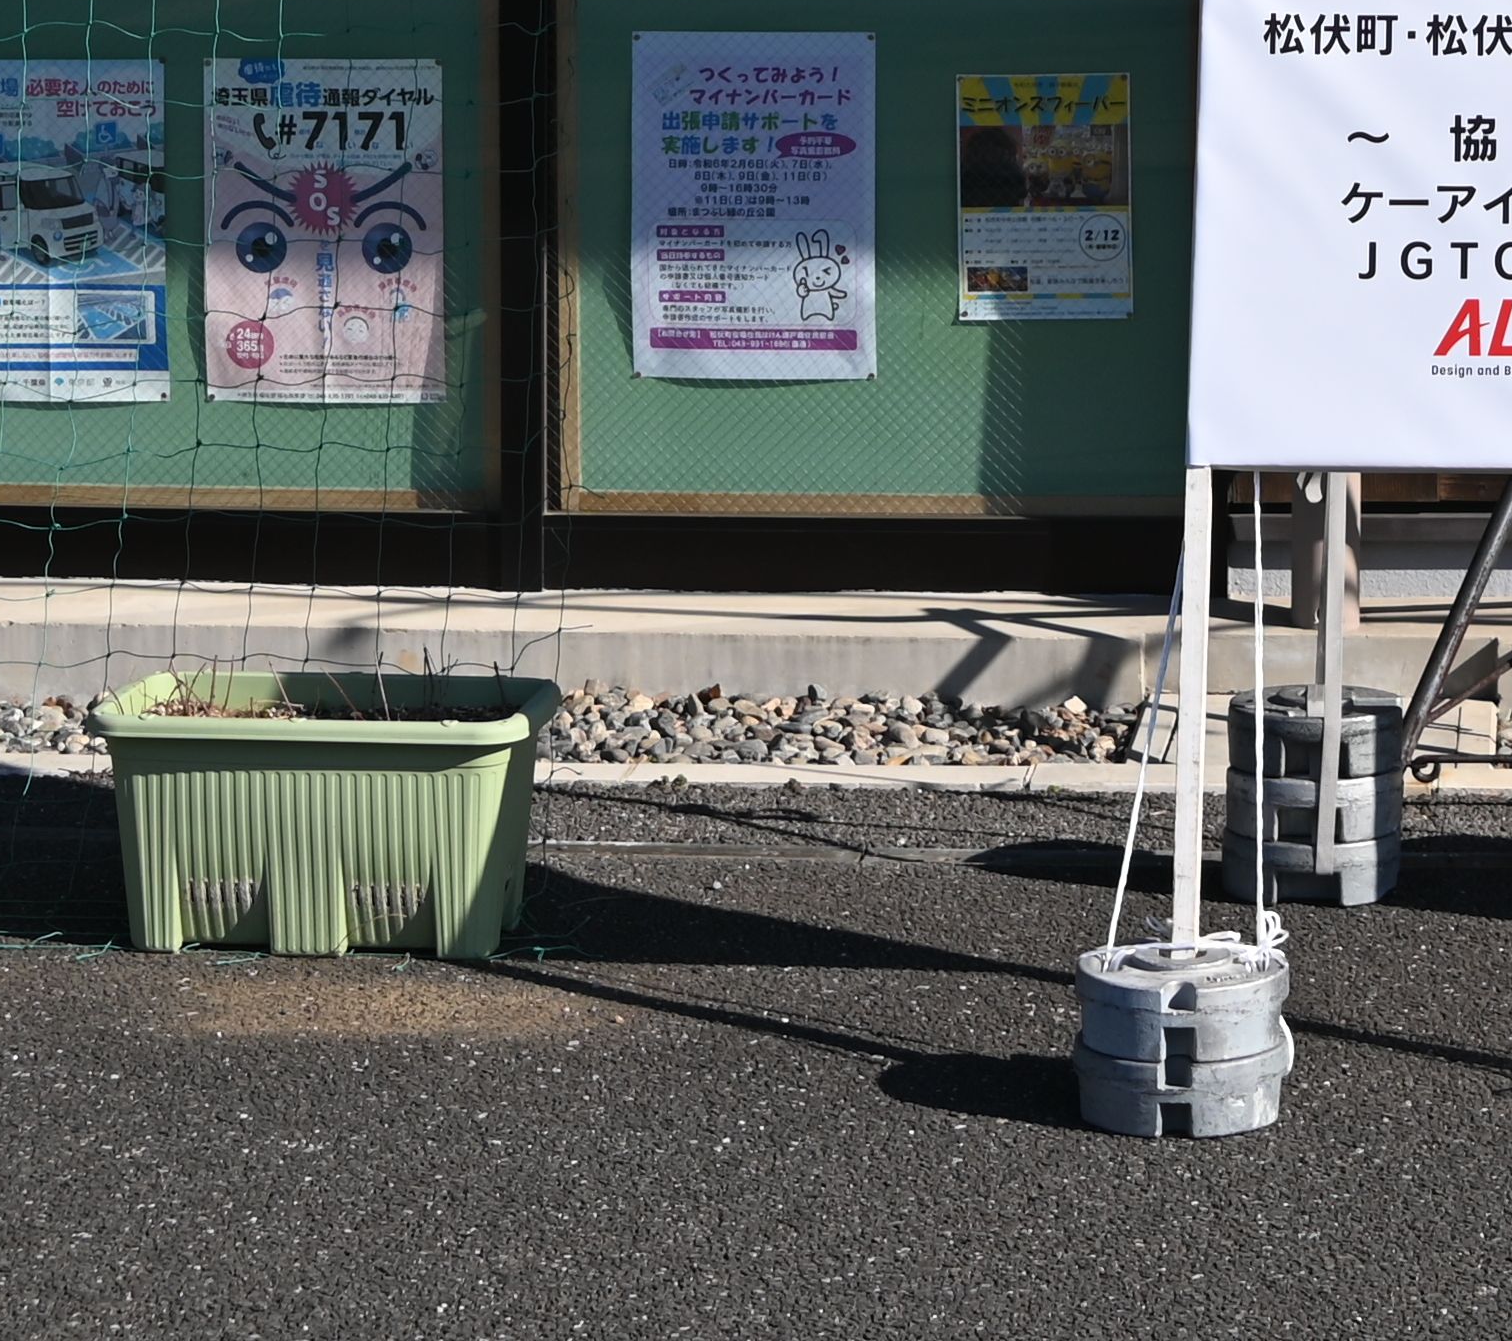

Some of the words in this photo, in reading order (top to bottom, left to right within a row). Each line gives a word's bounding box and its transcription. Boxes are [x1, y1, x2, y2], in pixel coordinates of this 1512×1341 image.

[699, 66, 839, 83] つくってみよう！
[689, 89, 852, 106] マイナンバーカード
[962, 95, 1126, 113] ミニオンスフィーバー
[56, 100, 157, 118] 空けておこう
[662, 111, 838, 131] 出張申請サポートを
[661, 135, 774, 155] 実施します！
[1084, 229, 1120, 242] 2/12
[1431, 364, 1473, 378] Design
[1477, 364, 1500, 377] and
